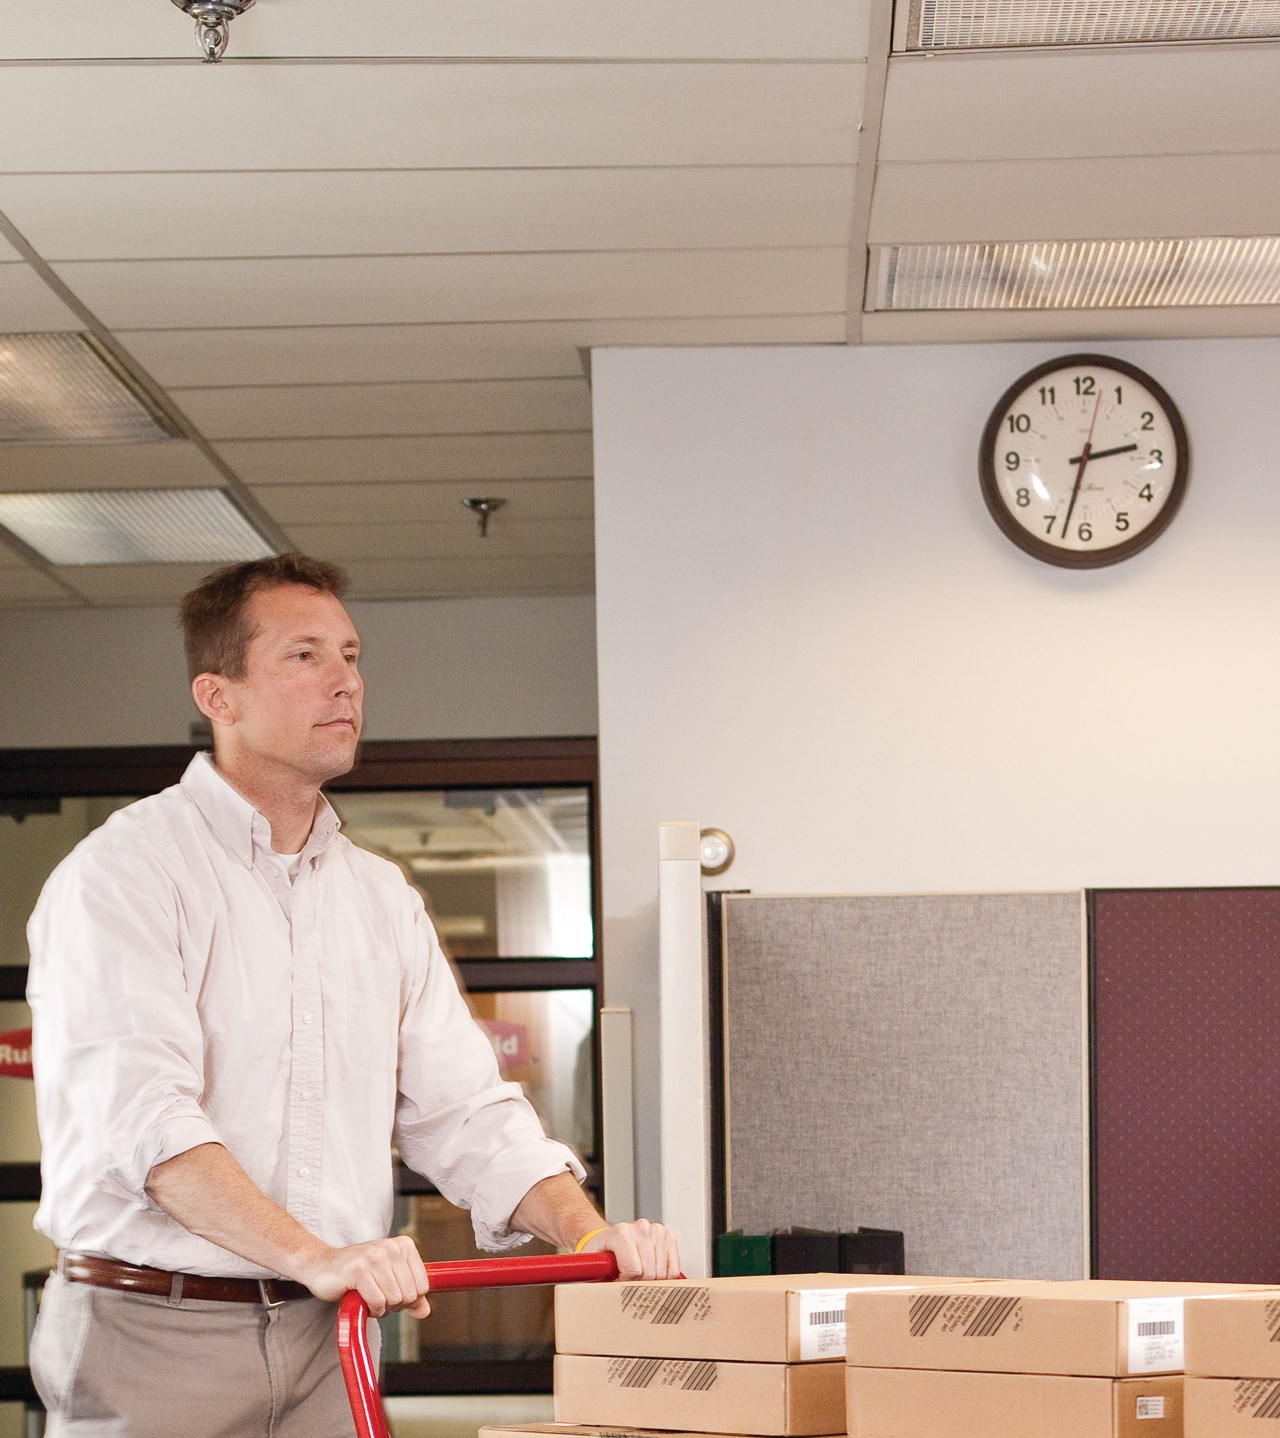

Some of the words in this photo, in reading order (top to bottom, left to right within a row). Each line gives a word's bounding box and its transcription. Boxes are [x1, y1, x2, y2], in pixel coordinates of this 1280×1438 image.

[1038, 386, 1056, 405] 11
[1073, 376, 1096, 396] 12
[1114, 386, 1123, 405] 1
[1007, 414, 1032, 433] 10
[1140, 411, 1155, 431] 2
[1005, 451, 1020, 471] 9
[1149, 449, 1163, 468] 3
[1016, 488, 1031, 507] 8
[1138, 483, 1154, 502] 4
[1043, 515, 1057, 534] 7
[1115, 512, 1130, 531] 5
[1077, 522, 1093, 541] 6
